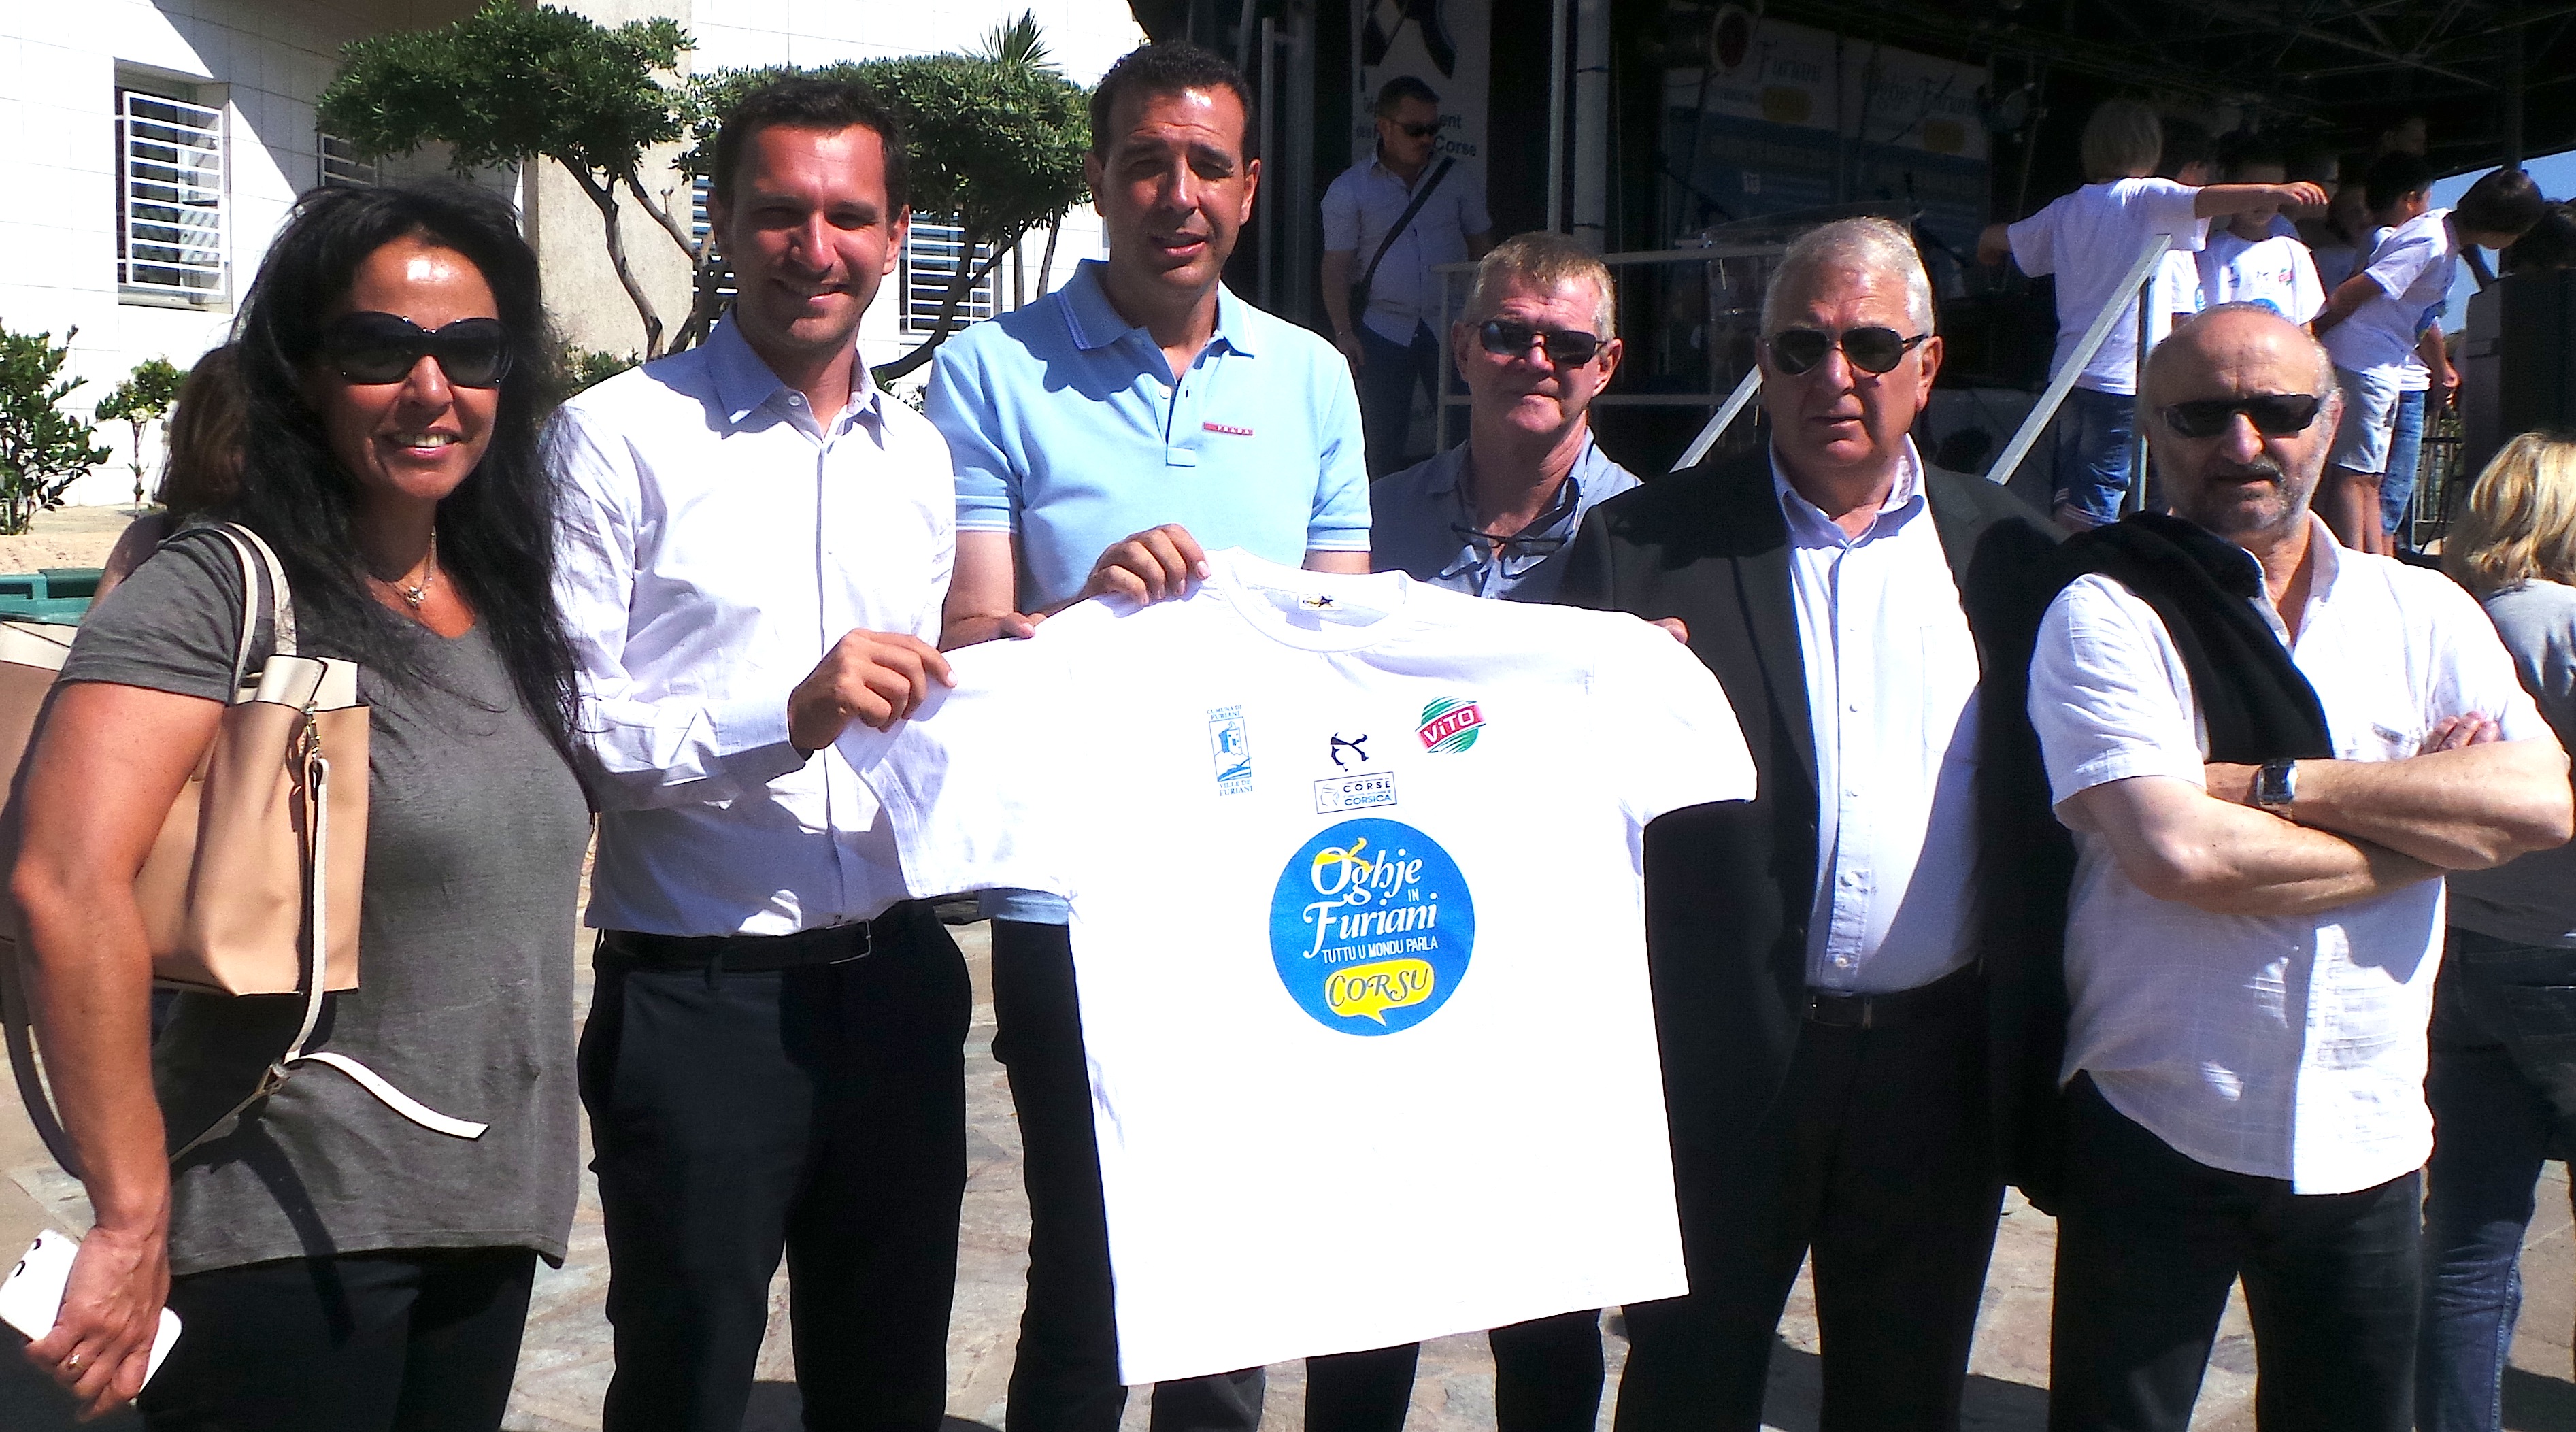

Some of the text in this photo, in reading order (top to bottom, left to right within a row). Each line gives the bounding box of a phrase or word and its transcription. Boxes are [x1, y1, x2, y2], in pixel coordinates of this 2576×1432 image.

[1211, 711, 1240, 720] FURIANI
[1219, 780, 1239, 788] VILLE
[1343, 781, 1390, 793] CORSE
[1219, 786, 1253, 797] FURIANI
[1344, 794, 1392, 805] CORSICA
[1311, 844, 1423, 905] Oghje
[1407, 888, 1420, 902] IN
[1303, 892, 1437, 959] Furiani
[1321, 935, 1439, 964] TUTTU U MONDU PARLA
[1329, 968, 1428, 1007] CORSU
